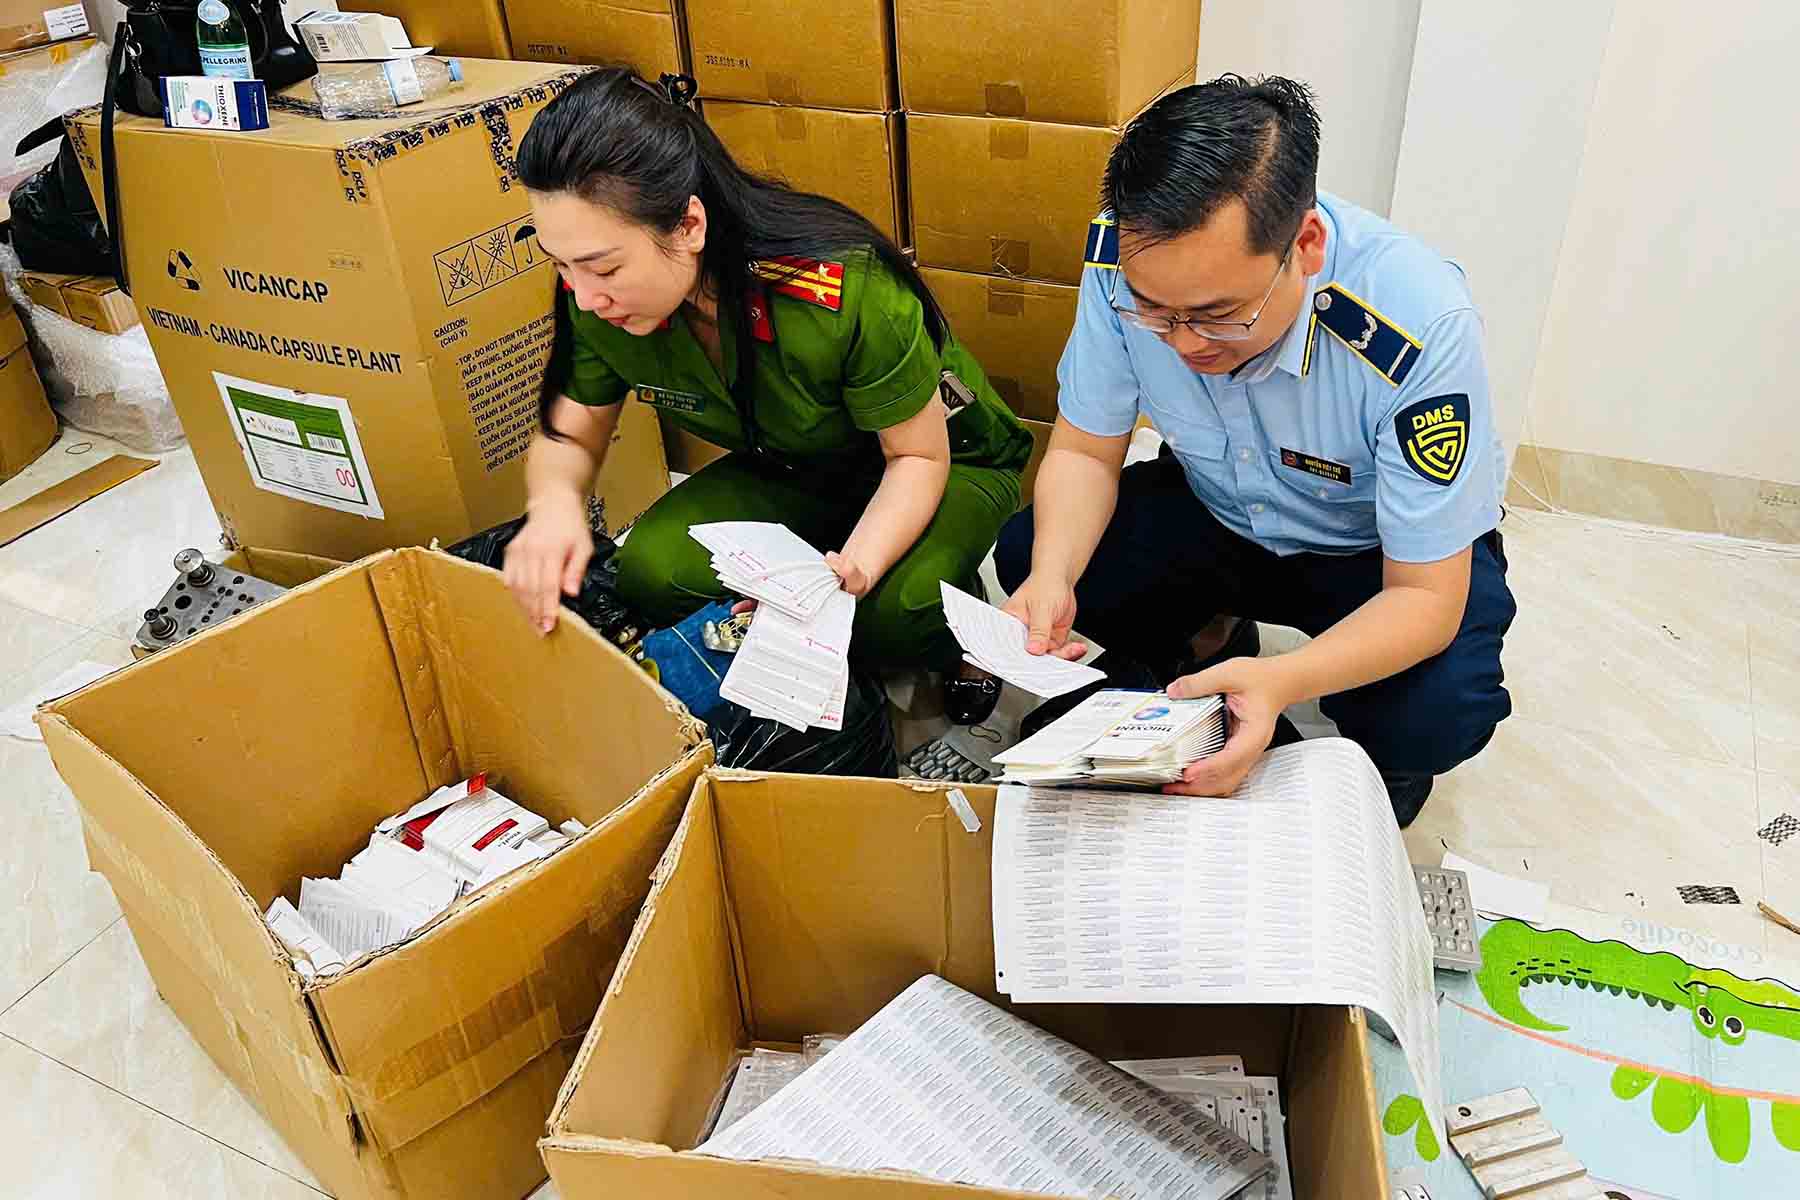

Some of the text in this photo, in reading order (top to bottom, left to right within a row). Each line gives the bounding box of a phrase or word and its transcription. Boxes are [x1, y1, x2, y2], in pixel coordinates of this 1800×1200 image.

[223, 267, 329, 304] VICANCAP
[146, 305, 202, 338] VIETNAM
[210, 322, 269, 354] CANADA
[269, 335, 345, 368] CAPSULE
[345, 348, 402, 375] PLANT
[475, 347, 484, 357] DO
[485, 341, 498, 352] NOT
[498, 332, 515, 346] TURN
[516, 327, 528, 337] THE
[528, 321, 541, 331] BOX
[465, 375, 483, 390] KEEP
[483, 371, 491, 380] IN
[490, 368, 497, 376] A
[496, 360, 514, 374] COOL
[515, 353, 527, 365] AND
[527, 347, 540, 358] DRY
[471, 399, 491, 413] STOW
[491, 389, 509, 403] AWAY
[510, 379, 527, 393] FROM
[528, 373, 540, 384] THE
[478, 400, 537, 435] KEEP BAGS SEALED
[1411, 404, 1455, 430] DMS
[484, 435, 517, 459] CONDITION
[335, 468, 356, 488] 00
